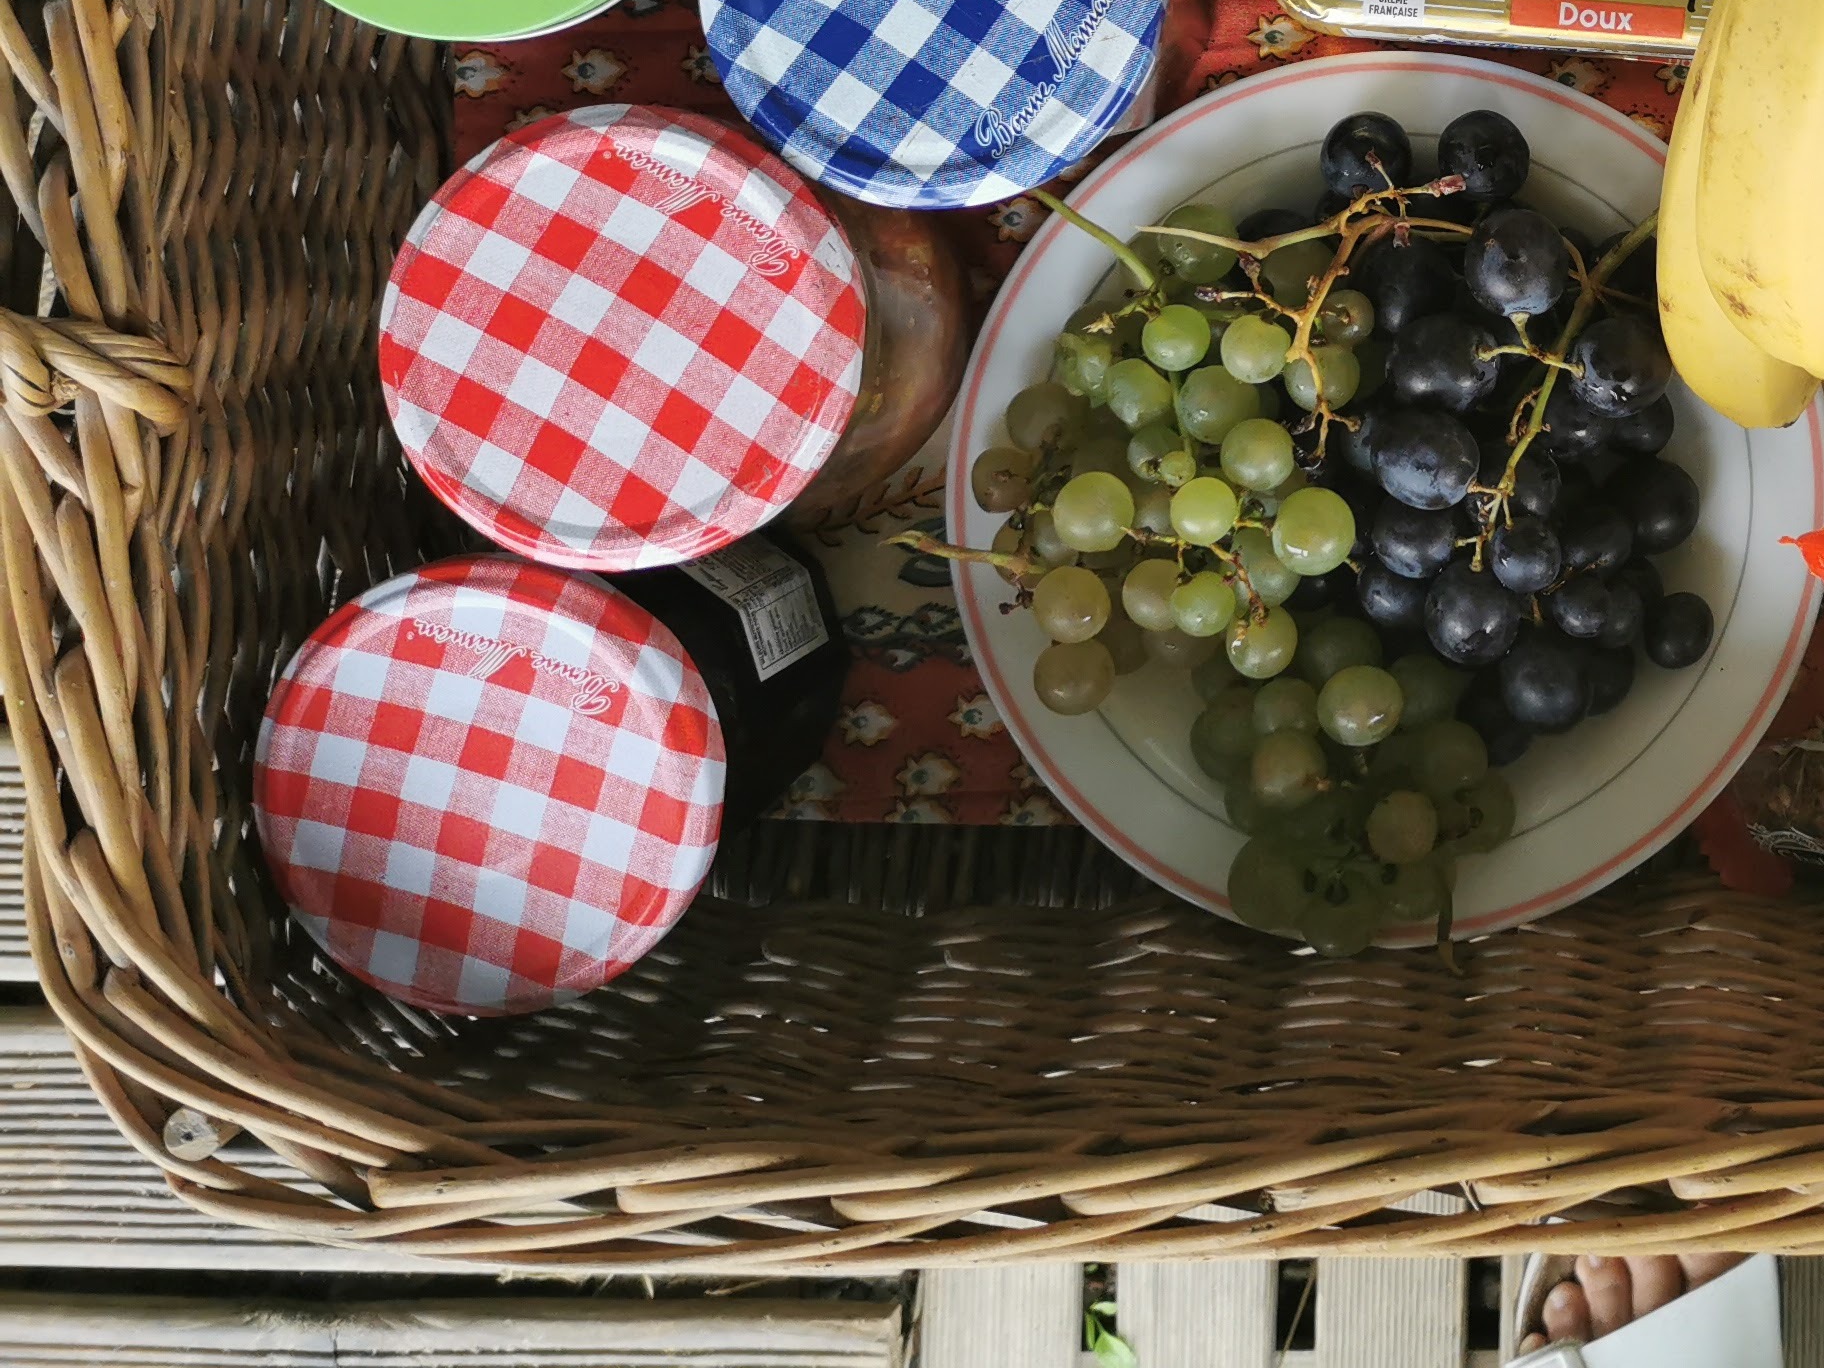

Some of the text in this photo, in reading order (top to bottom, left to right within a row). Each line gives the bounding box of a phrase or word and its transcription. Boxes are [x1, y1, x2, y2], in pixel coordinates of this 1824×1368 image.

[1368, 4, 1418, 19] FRANÇAISE
[1559, 1, 1634, 32] Doux
[974, 81, 1056, 159] Bonne
[614, 140, 800, 277] Bonne Maman
[413, 618, 620, 716] Bonne Maman
